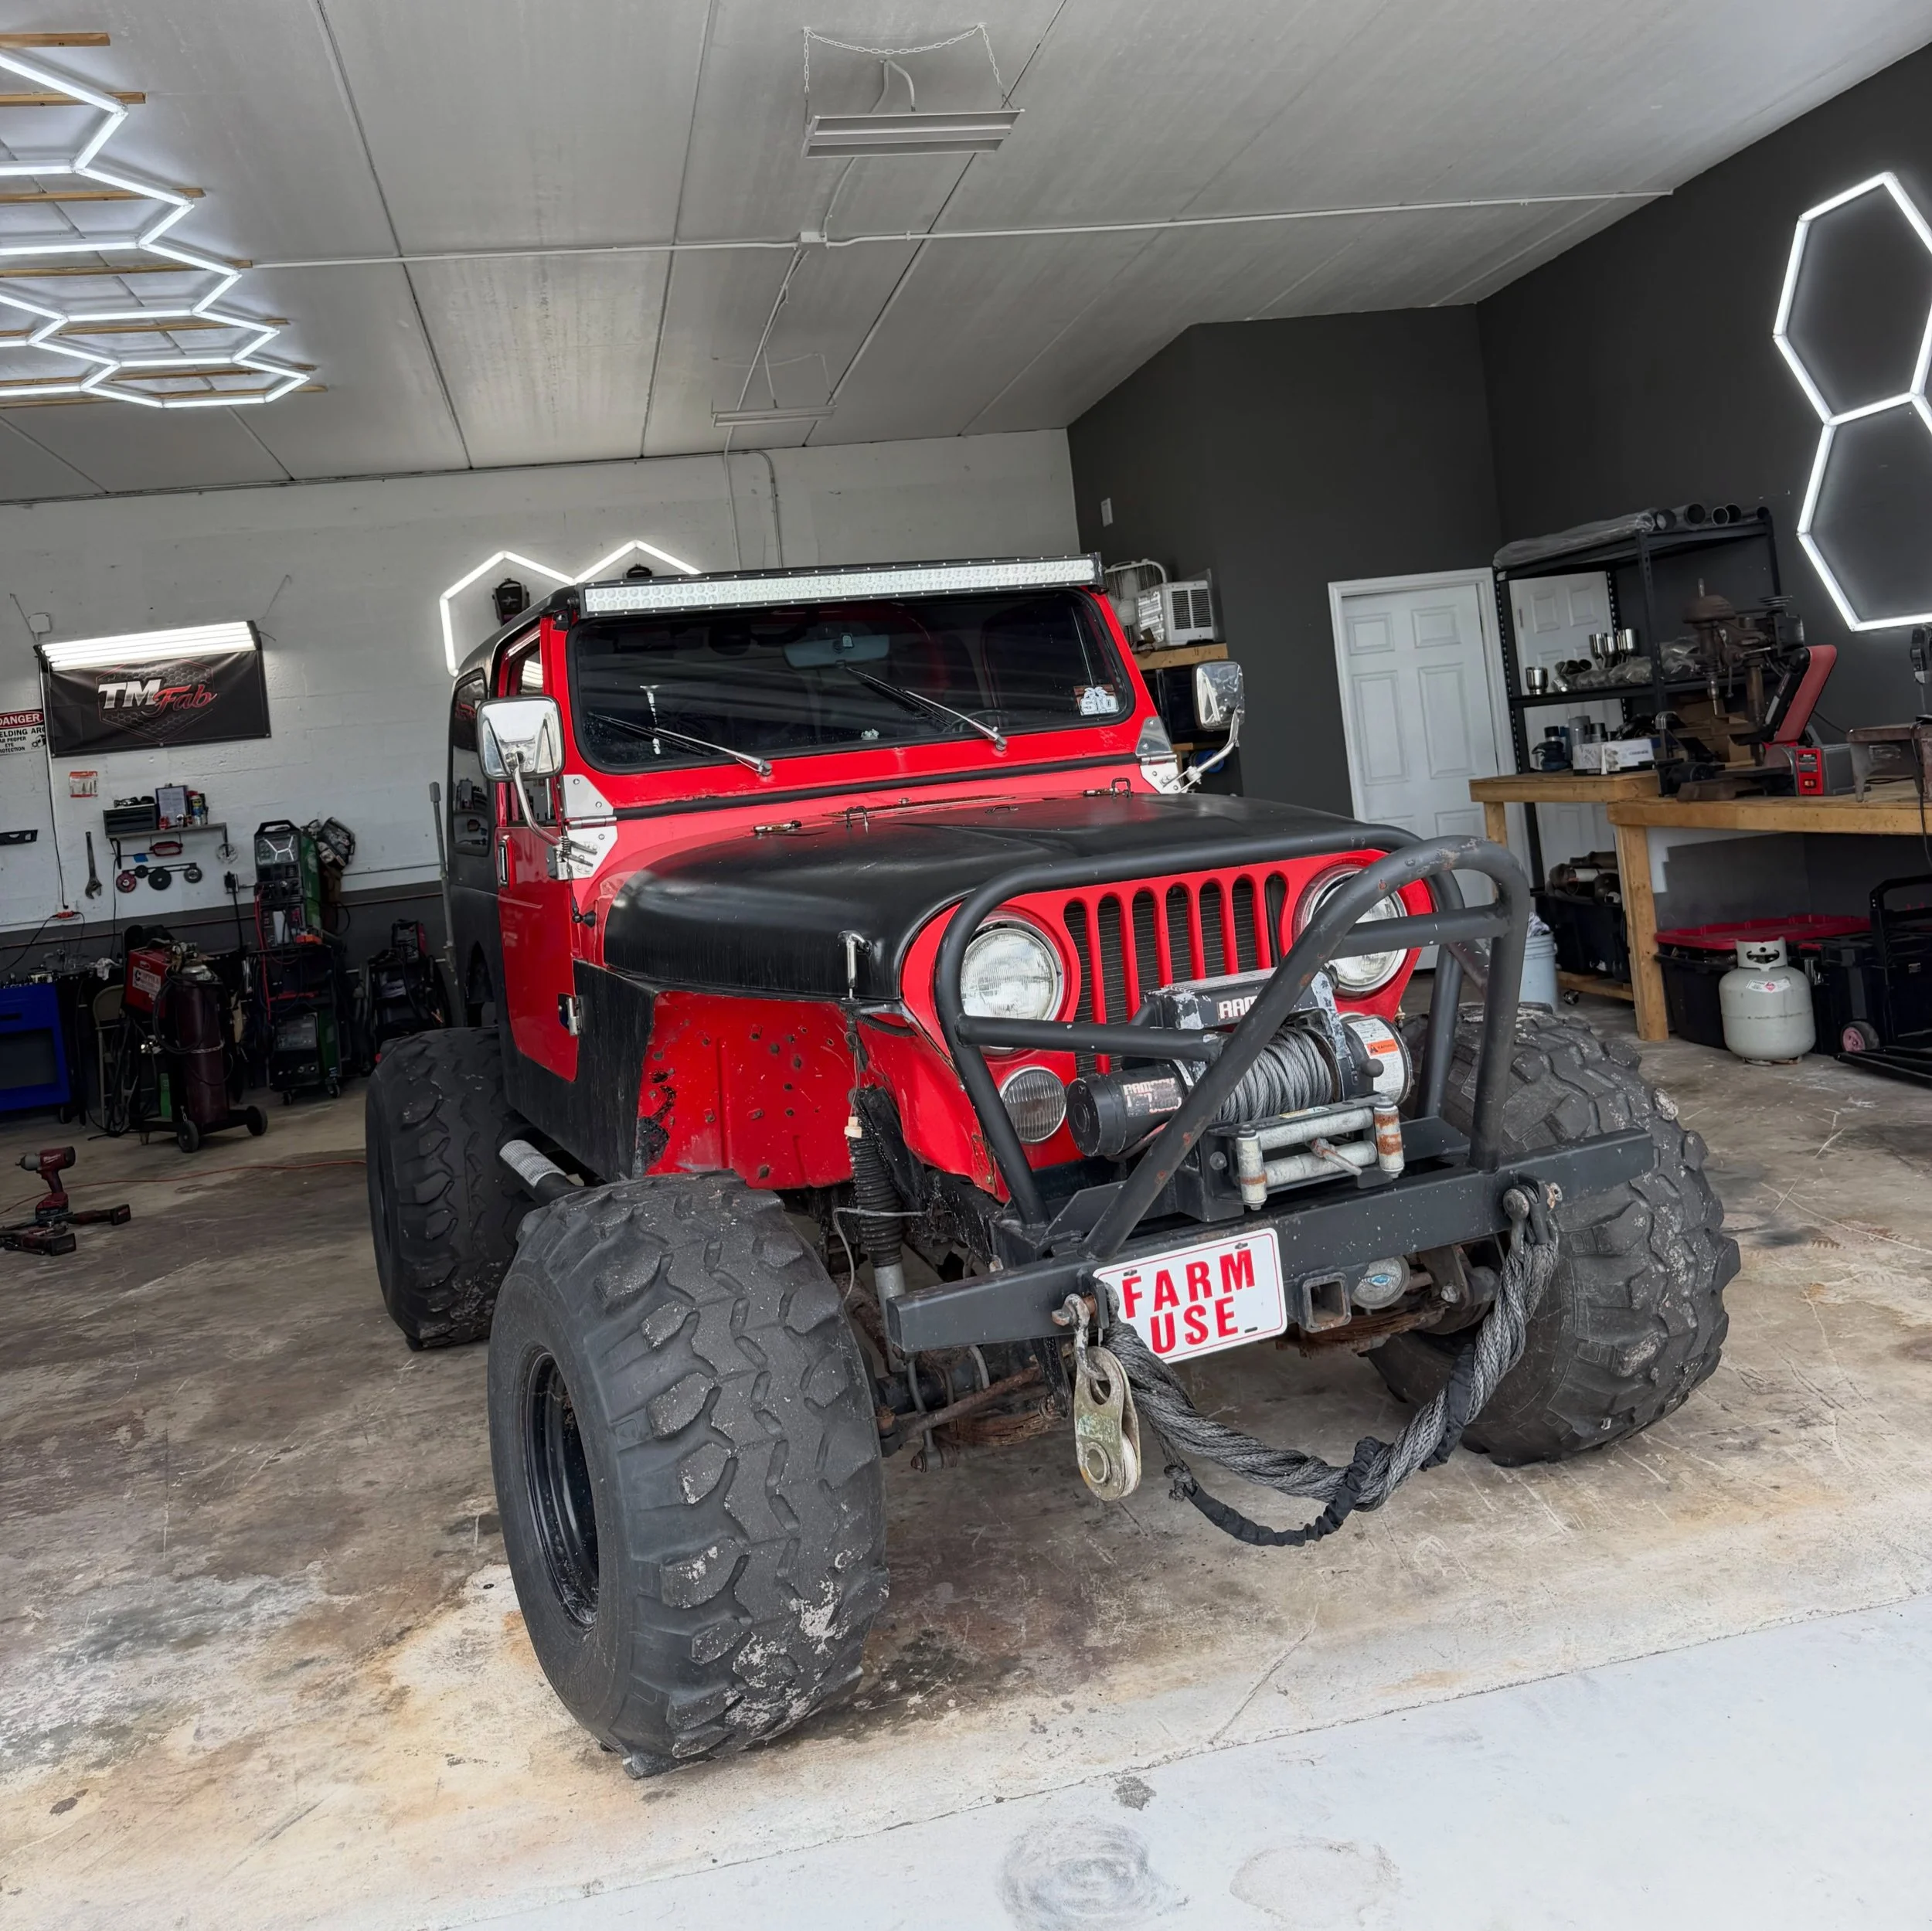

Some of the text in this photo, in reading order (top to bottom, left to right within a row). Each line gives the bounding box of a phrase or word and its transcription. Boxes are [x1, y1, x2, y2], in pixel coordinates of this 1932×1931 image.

[98, 679, 162, 709] TM
[0, 729, 28, 738] ELDING
[1121, 1249, 1256, 1319] FARM
[1149, 1296, 1239, 1355] USE
